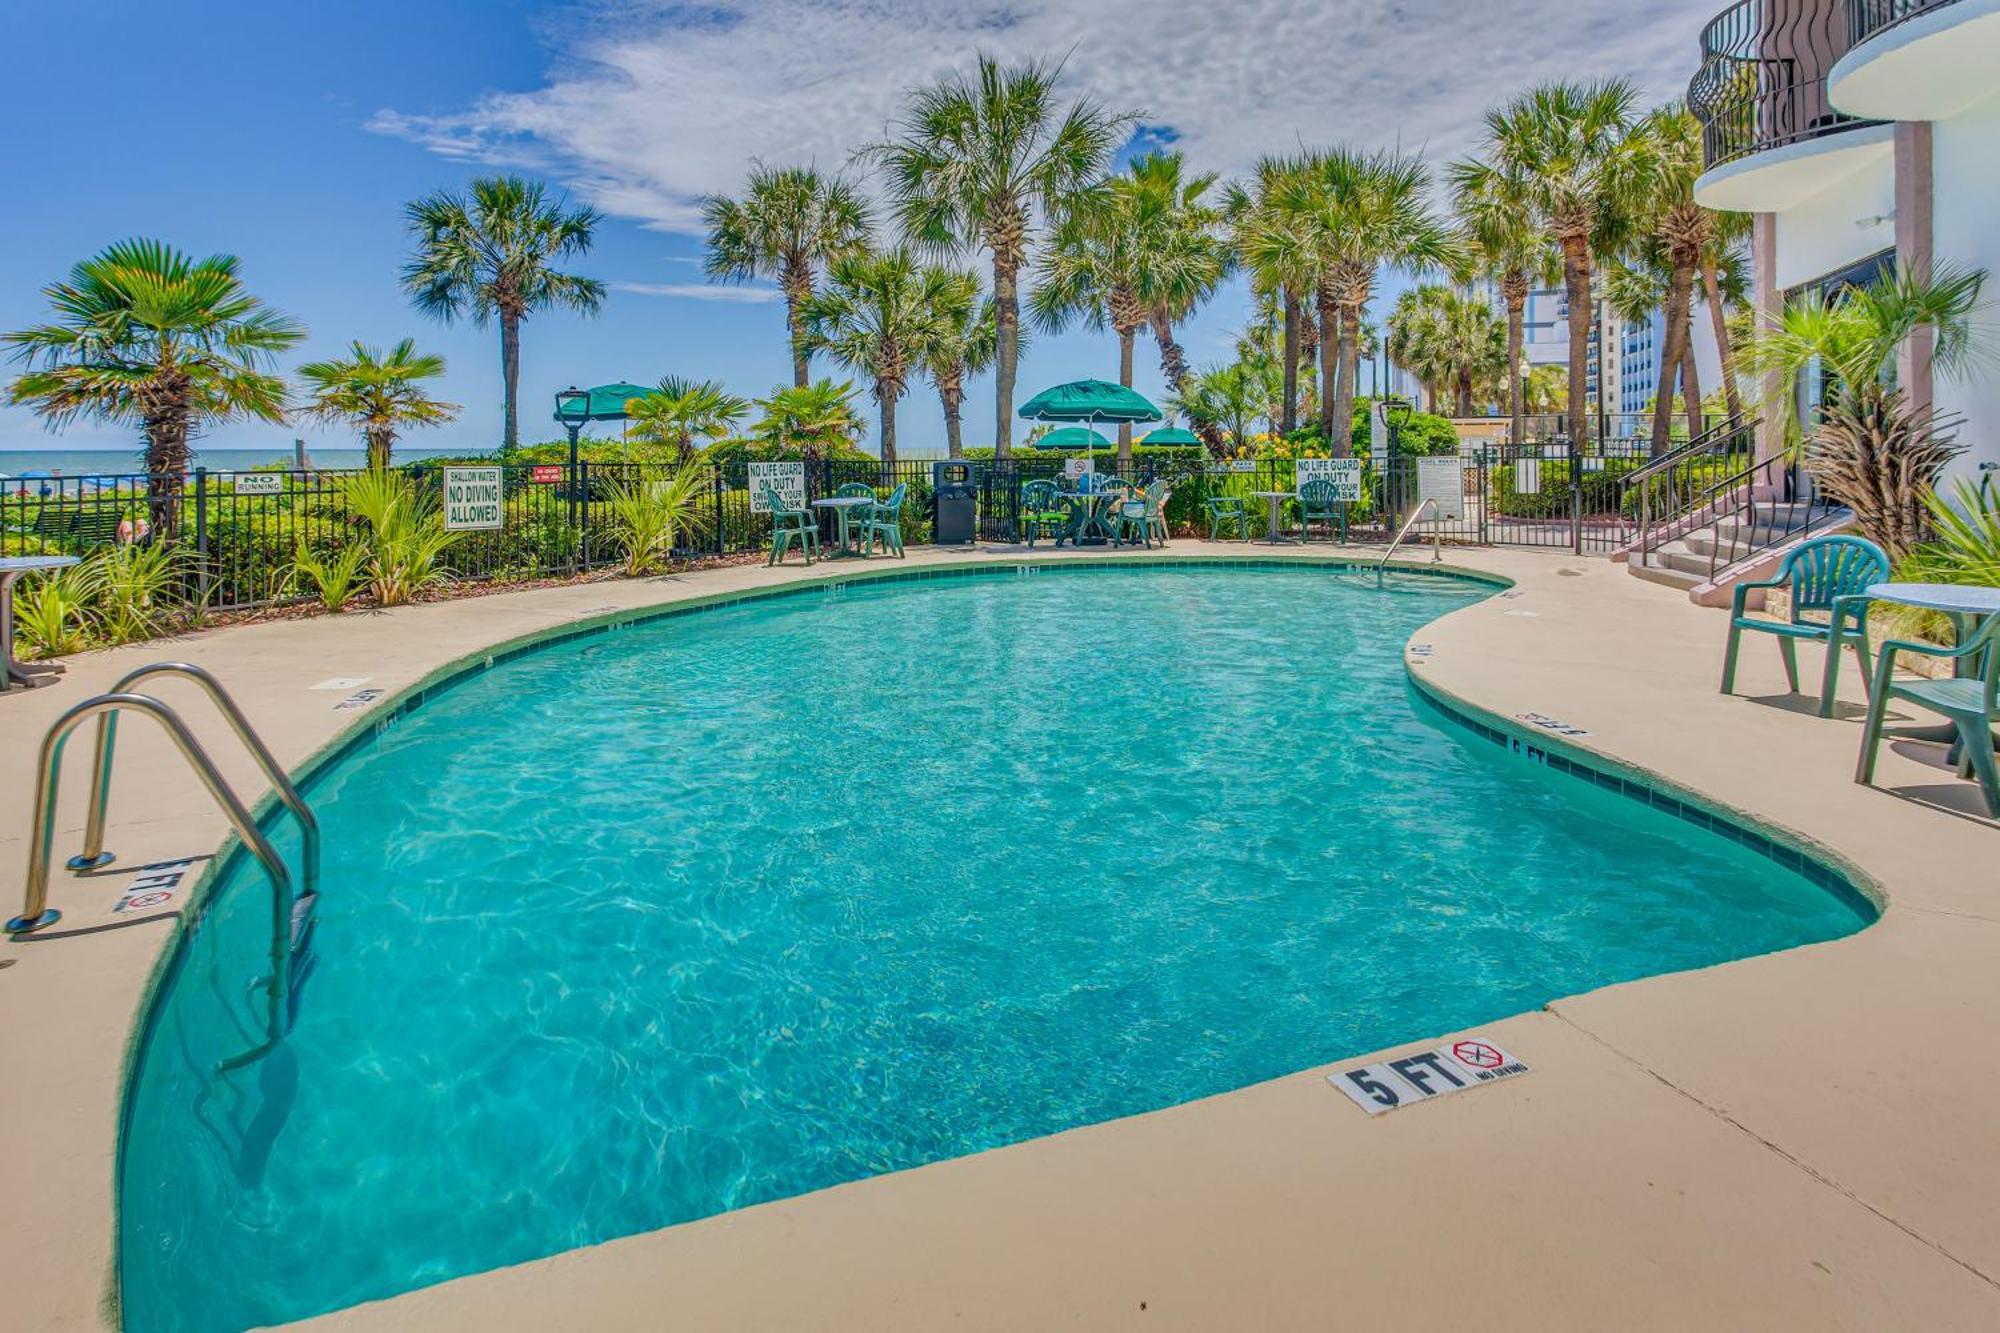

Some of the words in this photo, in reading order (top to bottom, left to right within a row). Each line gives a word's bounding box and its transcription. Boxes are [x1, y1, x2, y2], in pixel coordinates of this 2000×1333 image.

[750, 464, 761, 477] NO
[762, 463, 777, 476] LIFE
[779, 463, 802, 476] GUARD
[1298, 460, 1309, 471] NO
[1311, 460, 1329, 471] LIFE
[1330, 459, 1358, 470] GUARD
[450, 471, 478, 482] SHALLOW
[479, 471, 497, 481] WATER
[1323, 471, 1349, 483] DUTY
[238, 483, 281, 491] RUNNING
[760, 478, 772, 491] ON
[774, 477, 796, 490] DUTY
[449, 486, 464, 503] NO
[465, 485, 498, 502] DIVING
[784, 490, 802, 499] YOUR
[450, 505, 498, 522] ALLOWED
[1527, 744, 1546, 764] FT
[1475, 1071, 1495, 1080] NO
[1491, 1063, 1528, 1077] DIVING
[1345, 1069, 1399, 1106] 5
[1389, 1052, 1466, 1096] FT
